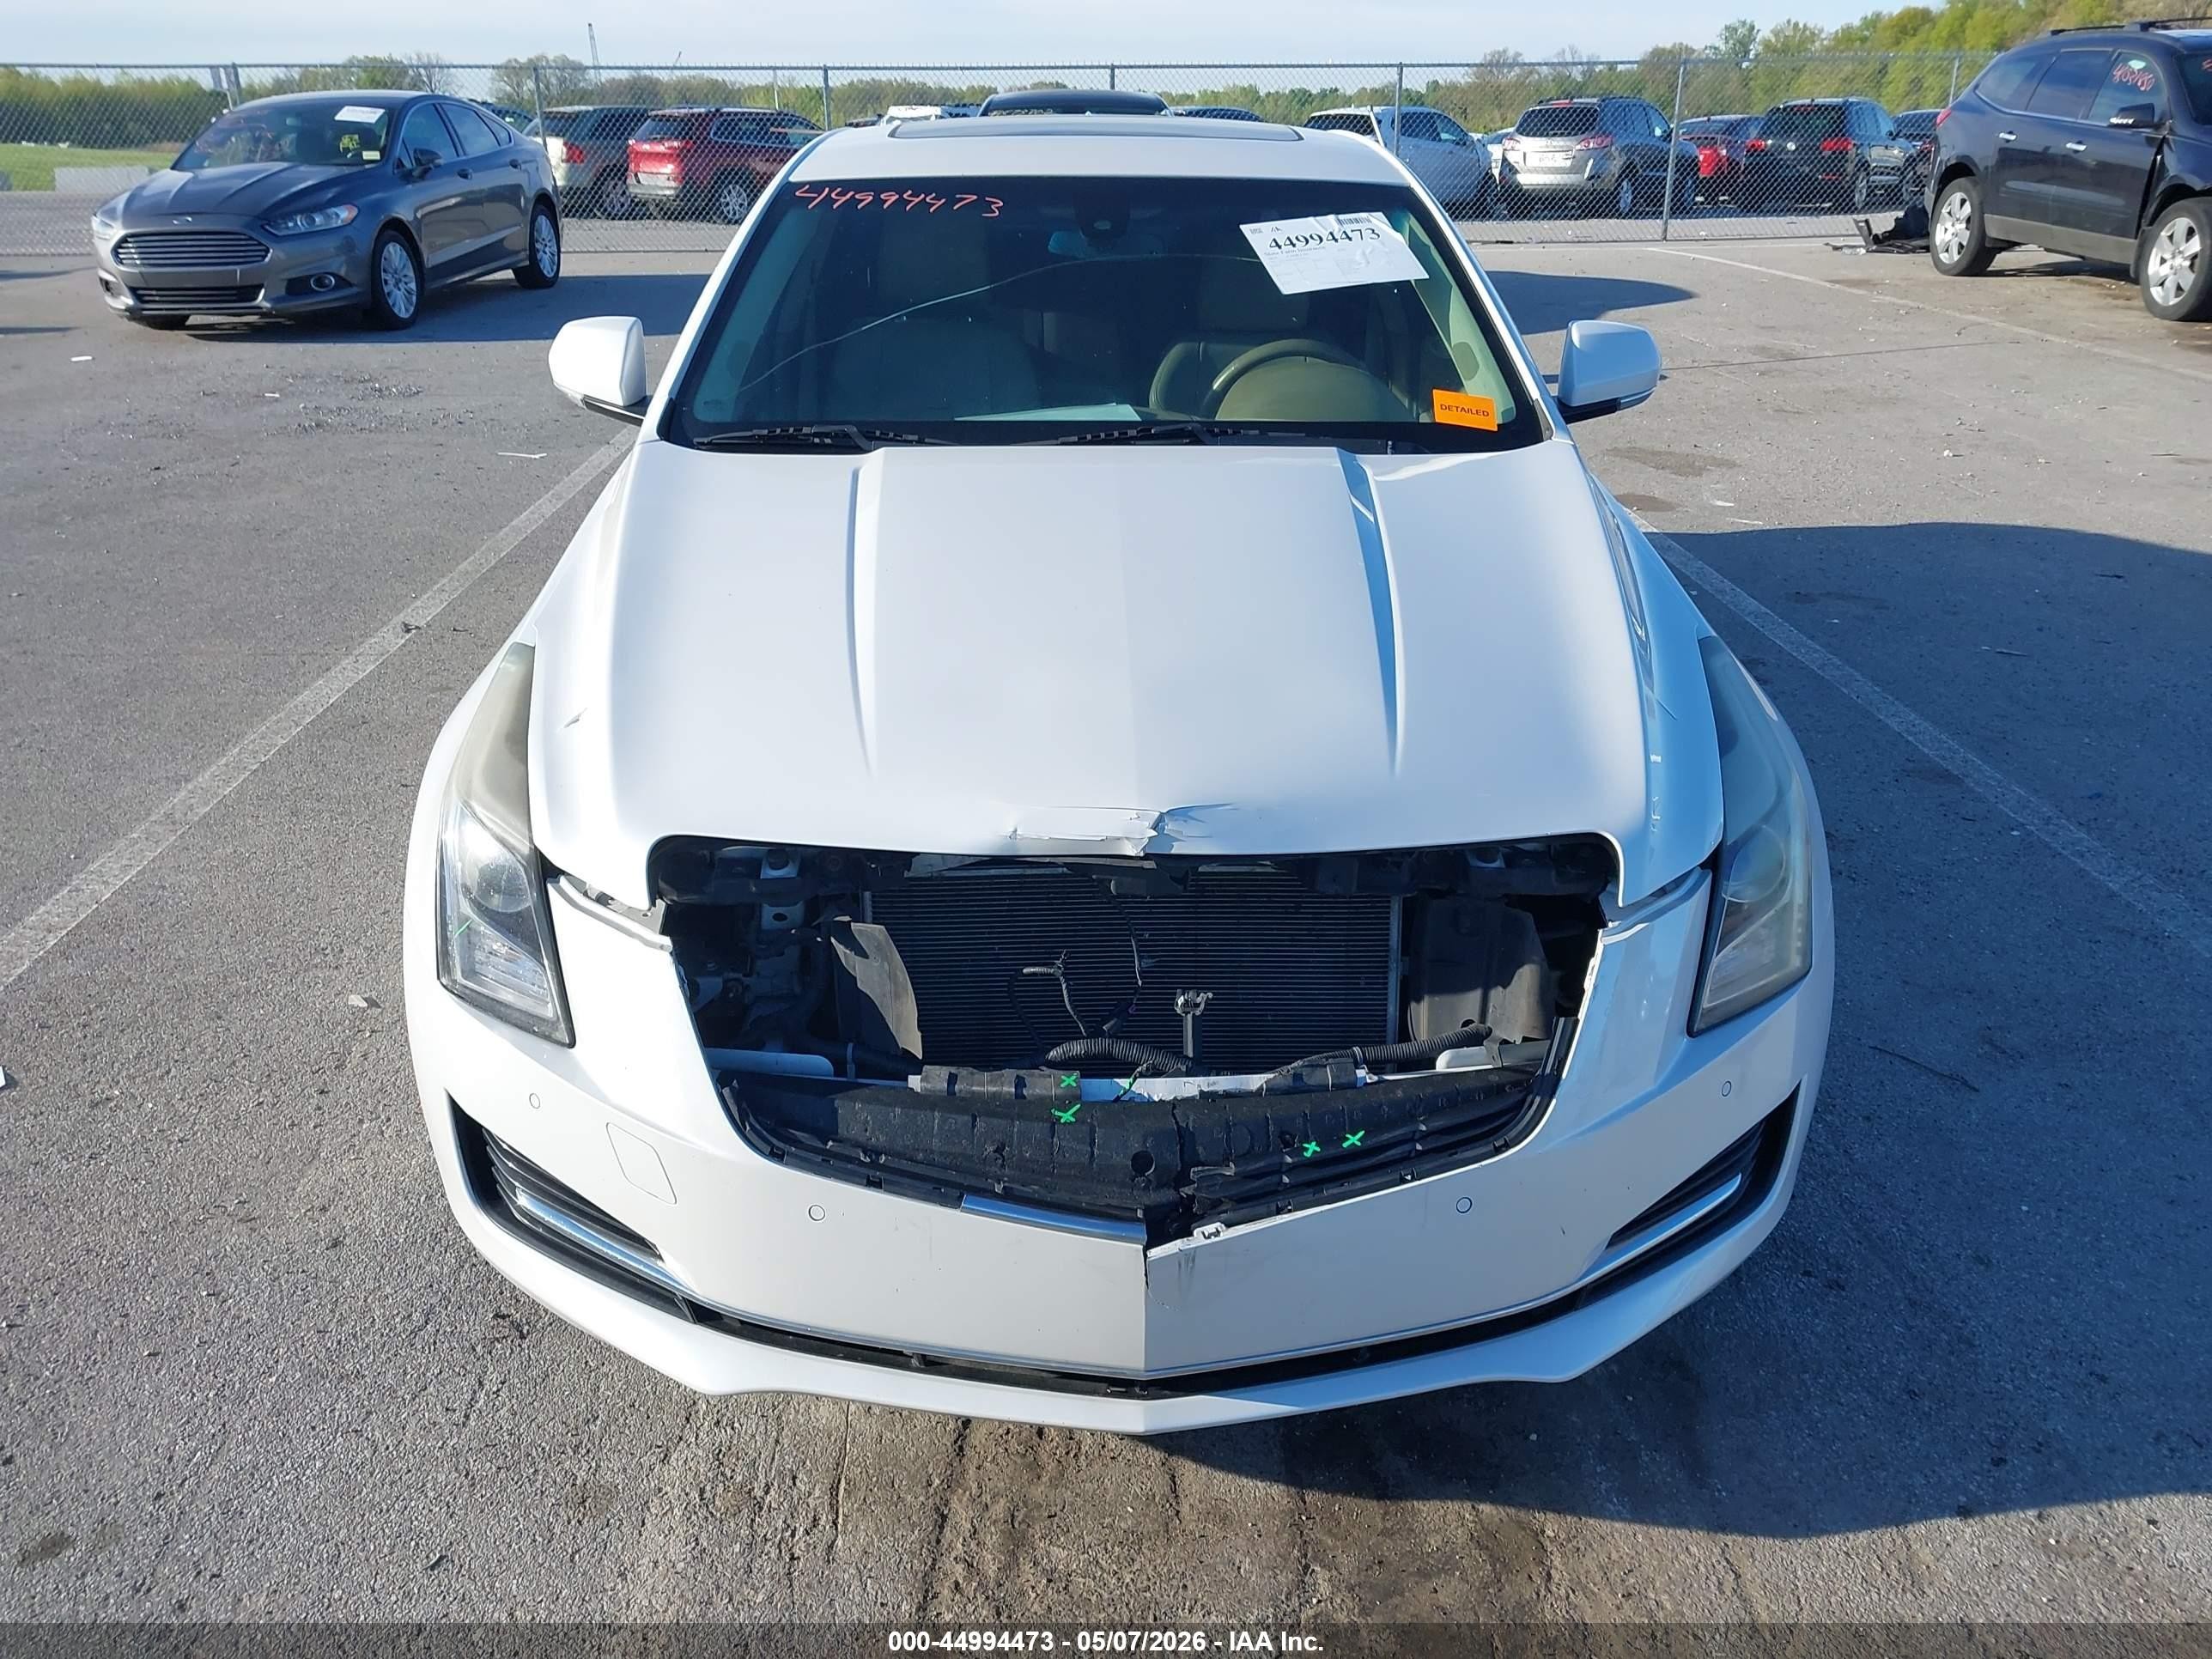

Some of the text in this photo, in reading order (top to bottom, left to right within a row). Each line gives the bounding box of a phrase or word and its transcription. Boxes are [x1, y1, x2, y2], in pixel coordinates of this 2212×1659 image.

[795, 184, 1004, 217] 44994473
[1268, 228, 1381, 250] 44994473
[1440, 403, 1490, 417] DETAILED
